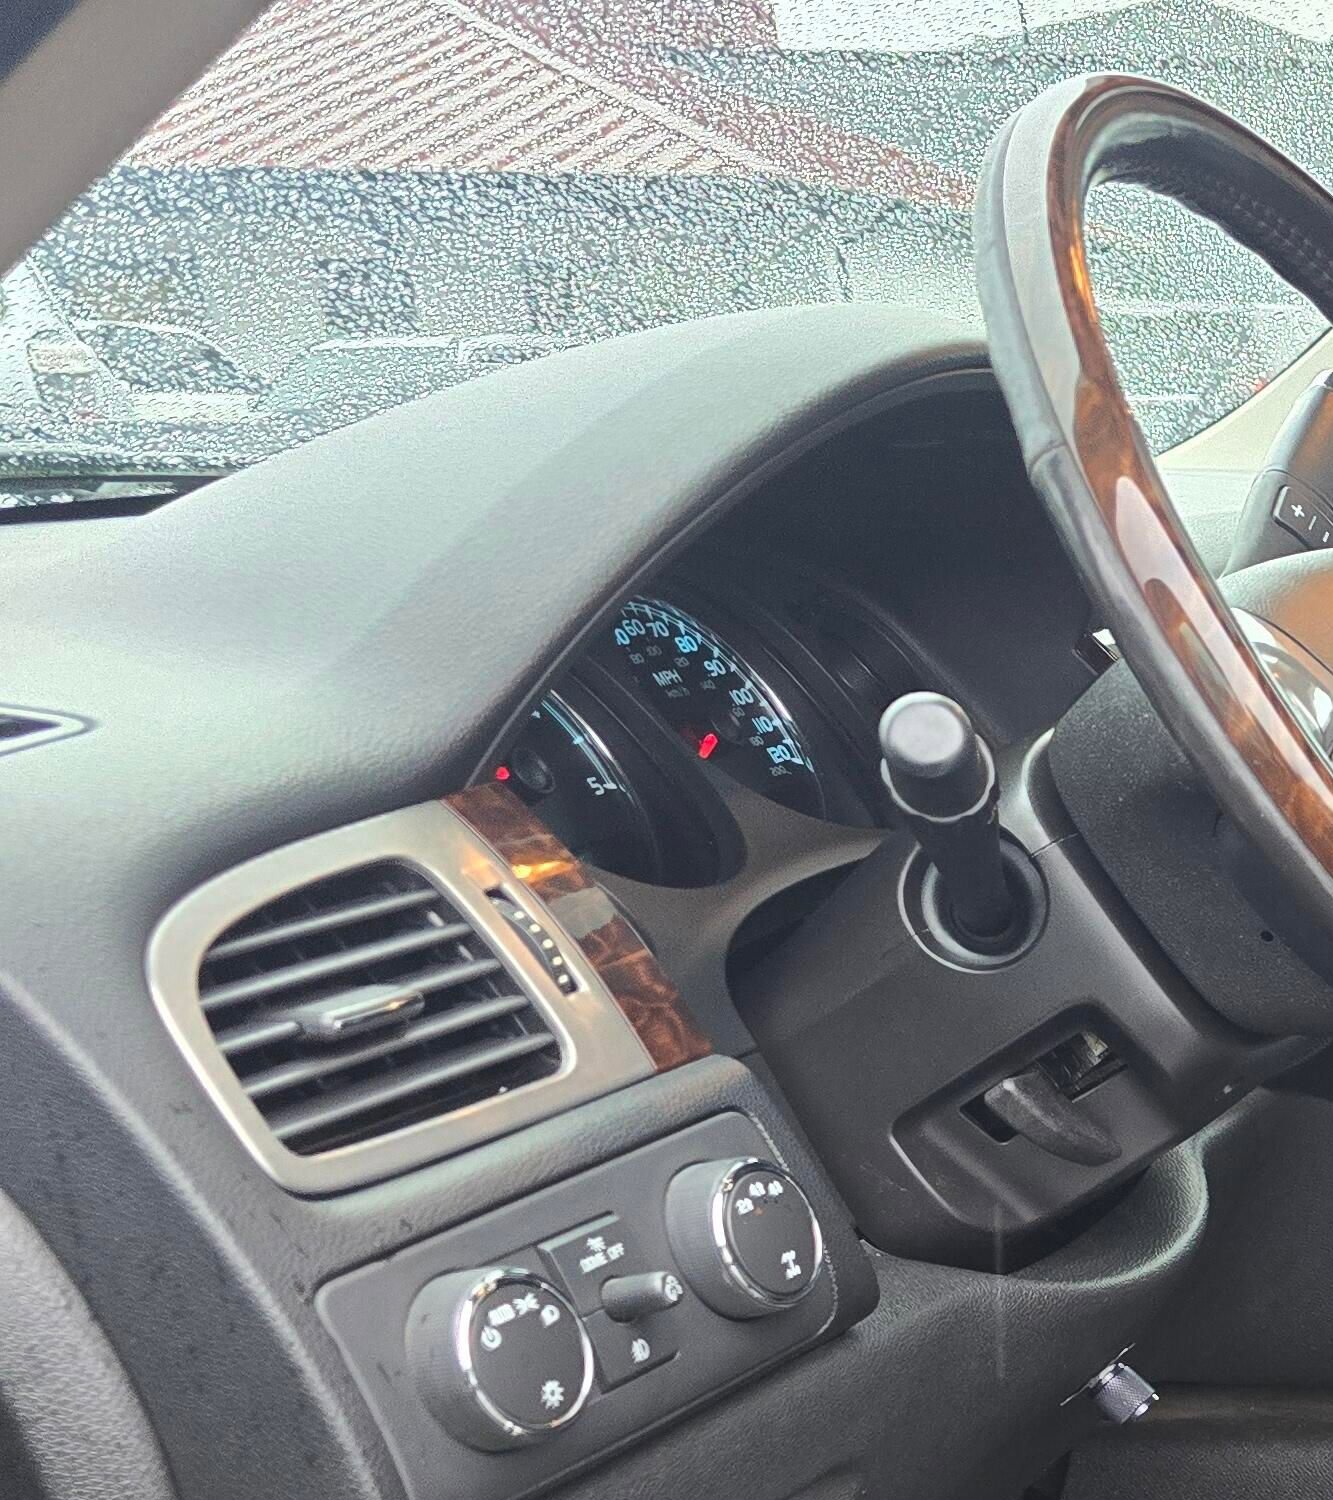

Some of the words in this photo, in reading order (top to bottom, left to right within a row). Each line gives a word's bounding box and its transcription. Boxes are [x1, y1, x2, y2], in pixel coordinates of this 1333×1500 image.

[622, 619, 646, 636] 60
[646, 621, 669, 638] 70
[674, 635, 698, 653] 80
[652, 668, 683, 687] MPH
[703, 659, 727, 677] 90
[728, 687, 754, 706] 100
[751, 715, 774, 734] 110
[766, 745, 791, 764] 120
[586, 776, 605, 796] 5
